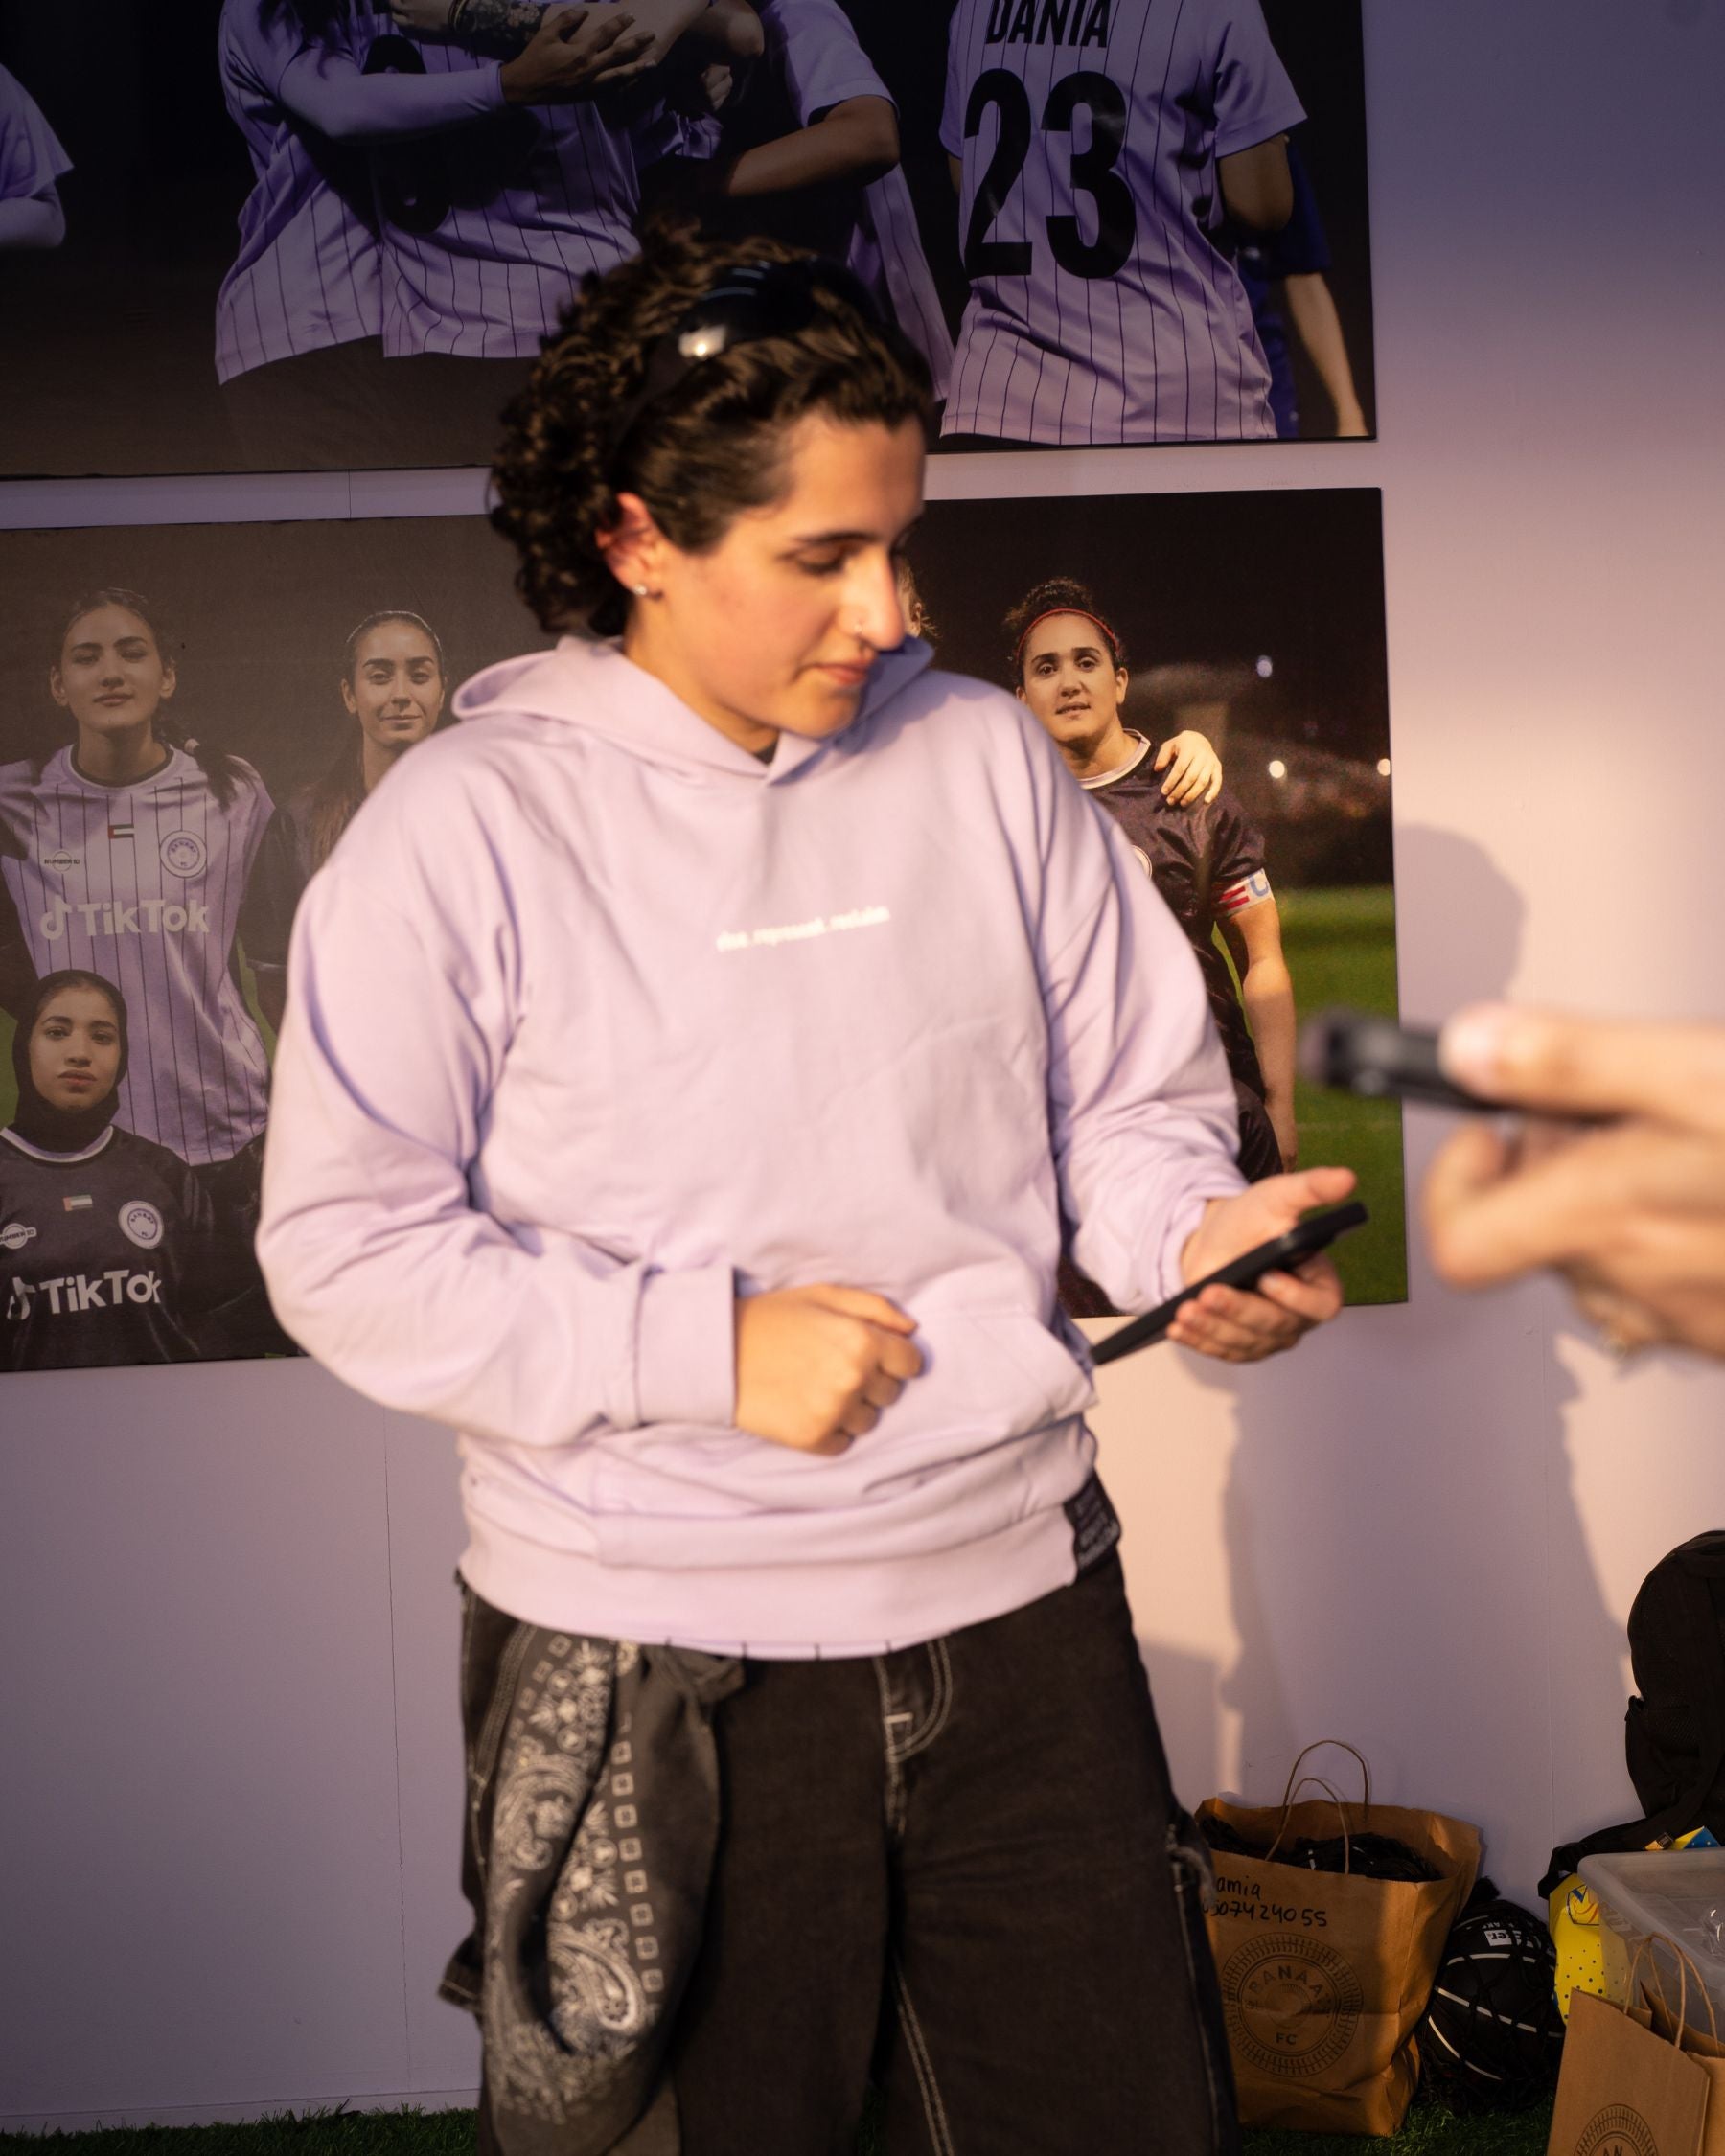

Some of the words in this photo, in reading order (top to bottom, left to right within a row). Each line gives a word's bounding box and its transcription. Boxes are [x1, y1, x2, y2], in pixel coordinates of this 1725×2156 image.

[985, 0, 1109, 47] DANIA
[964, 68, 1136, 280] 23
[77, 899, 210, 936] TikTok
[39, 1269, 162, 1315] TikTok
[1216, 1875, 1261, 1900] amia
[1276, 2032, 1298, 2046] FC
